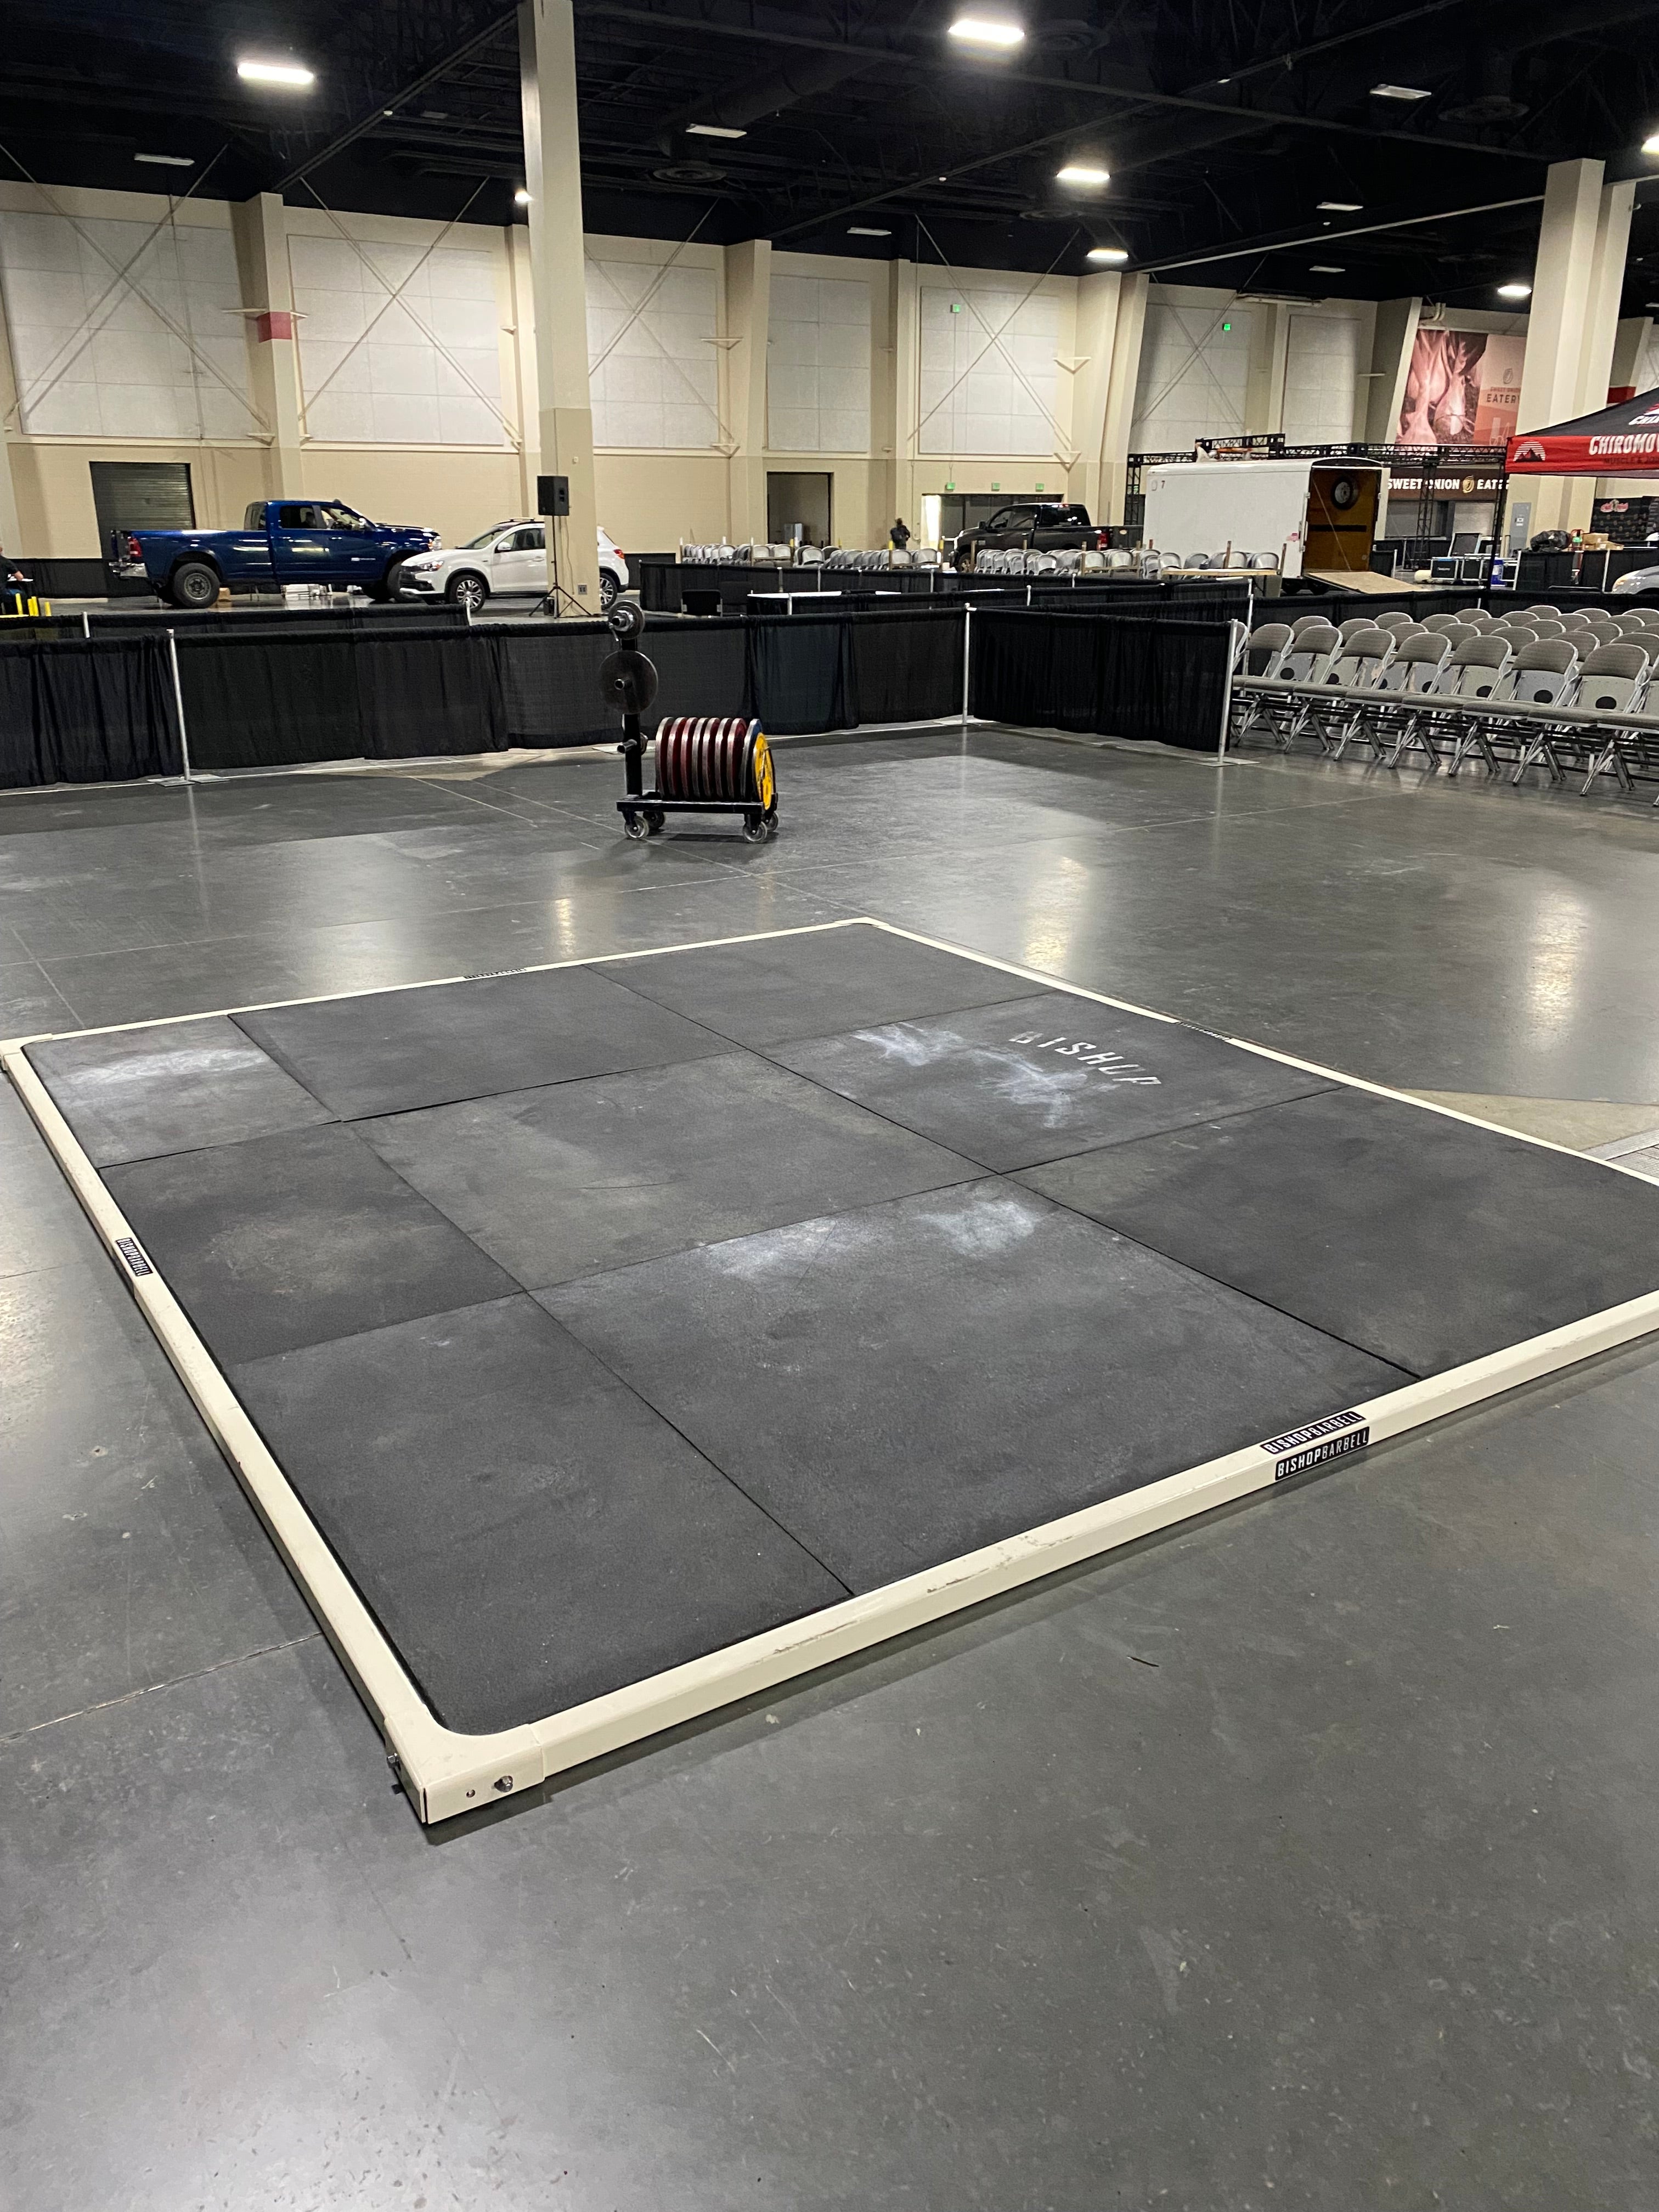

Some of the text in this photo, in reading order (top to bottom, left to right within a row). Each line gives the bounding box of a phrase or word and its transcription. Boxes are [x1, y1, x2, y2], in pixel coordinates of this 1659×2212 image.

[1387, 478, 1423, 489] SWEET
[116, 1238, 151, 1277] BISHOPBARBELL
[1263, 1413, 1363, 1453] BISHOPBARBELL
[1277, 1430, 1368, 1477] BISHOPBARBELL
